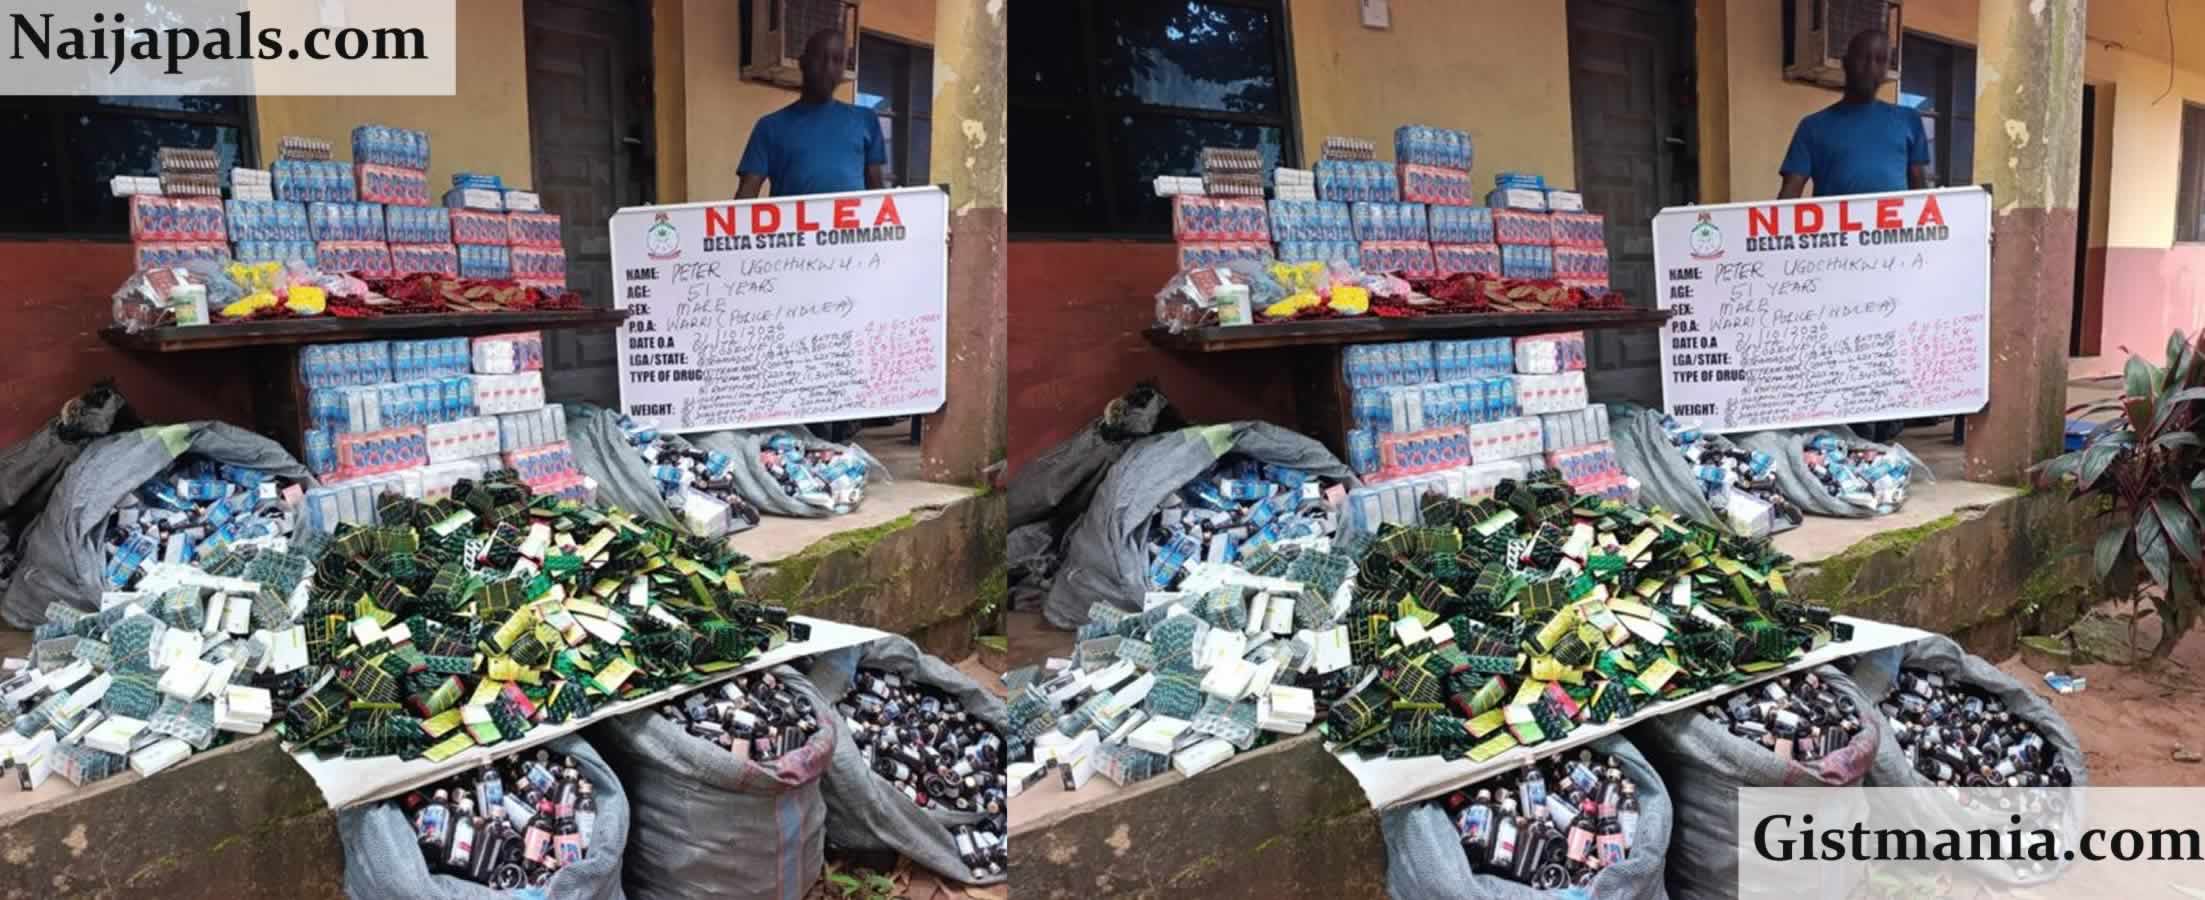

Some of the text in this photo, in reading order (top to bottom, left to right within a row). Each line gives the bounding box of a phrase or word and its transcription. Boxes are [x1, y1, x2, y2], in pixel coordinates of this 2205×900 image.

[704, 194, 903, 238] NDLEA
[1747, 194, 1946, 238] NDLEA
[703, 226, 906, 252] DELTA STATE COMMAND
[1746, 226, 1949, 252] DELTA STATE COMMAND
[626, 268, 660, 281] NAME:
[671, 261, 721, 284] PETER
[1669, 268, 1703, 281] NAME:
[1714, 261, 1764, 284] PETER
[627, 285, 651, 298] AGE:
[724, 277, 777, 296] YEARS
[1670, 285, 1694, 298] AGE:
[1767, 277, 1820, 296] YEARS
[628, 303, 651, 316] SEX:
[1671, 303, 1694, 316] SEX:
[629, 337, 656, 349] DATE
[1672, 337, 1699, 349] DATE
[630, 371, 655, 383] TYPE
[657, 370, 671, 382] OF
[1673, 371, 1698, 383] TYPE
[1700, 370, 1714, 382] OF
[630, 404, 676, 417] WEIGHT:
[1673, 404, 1719, 417] WEIGHT:
